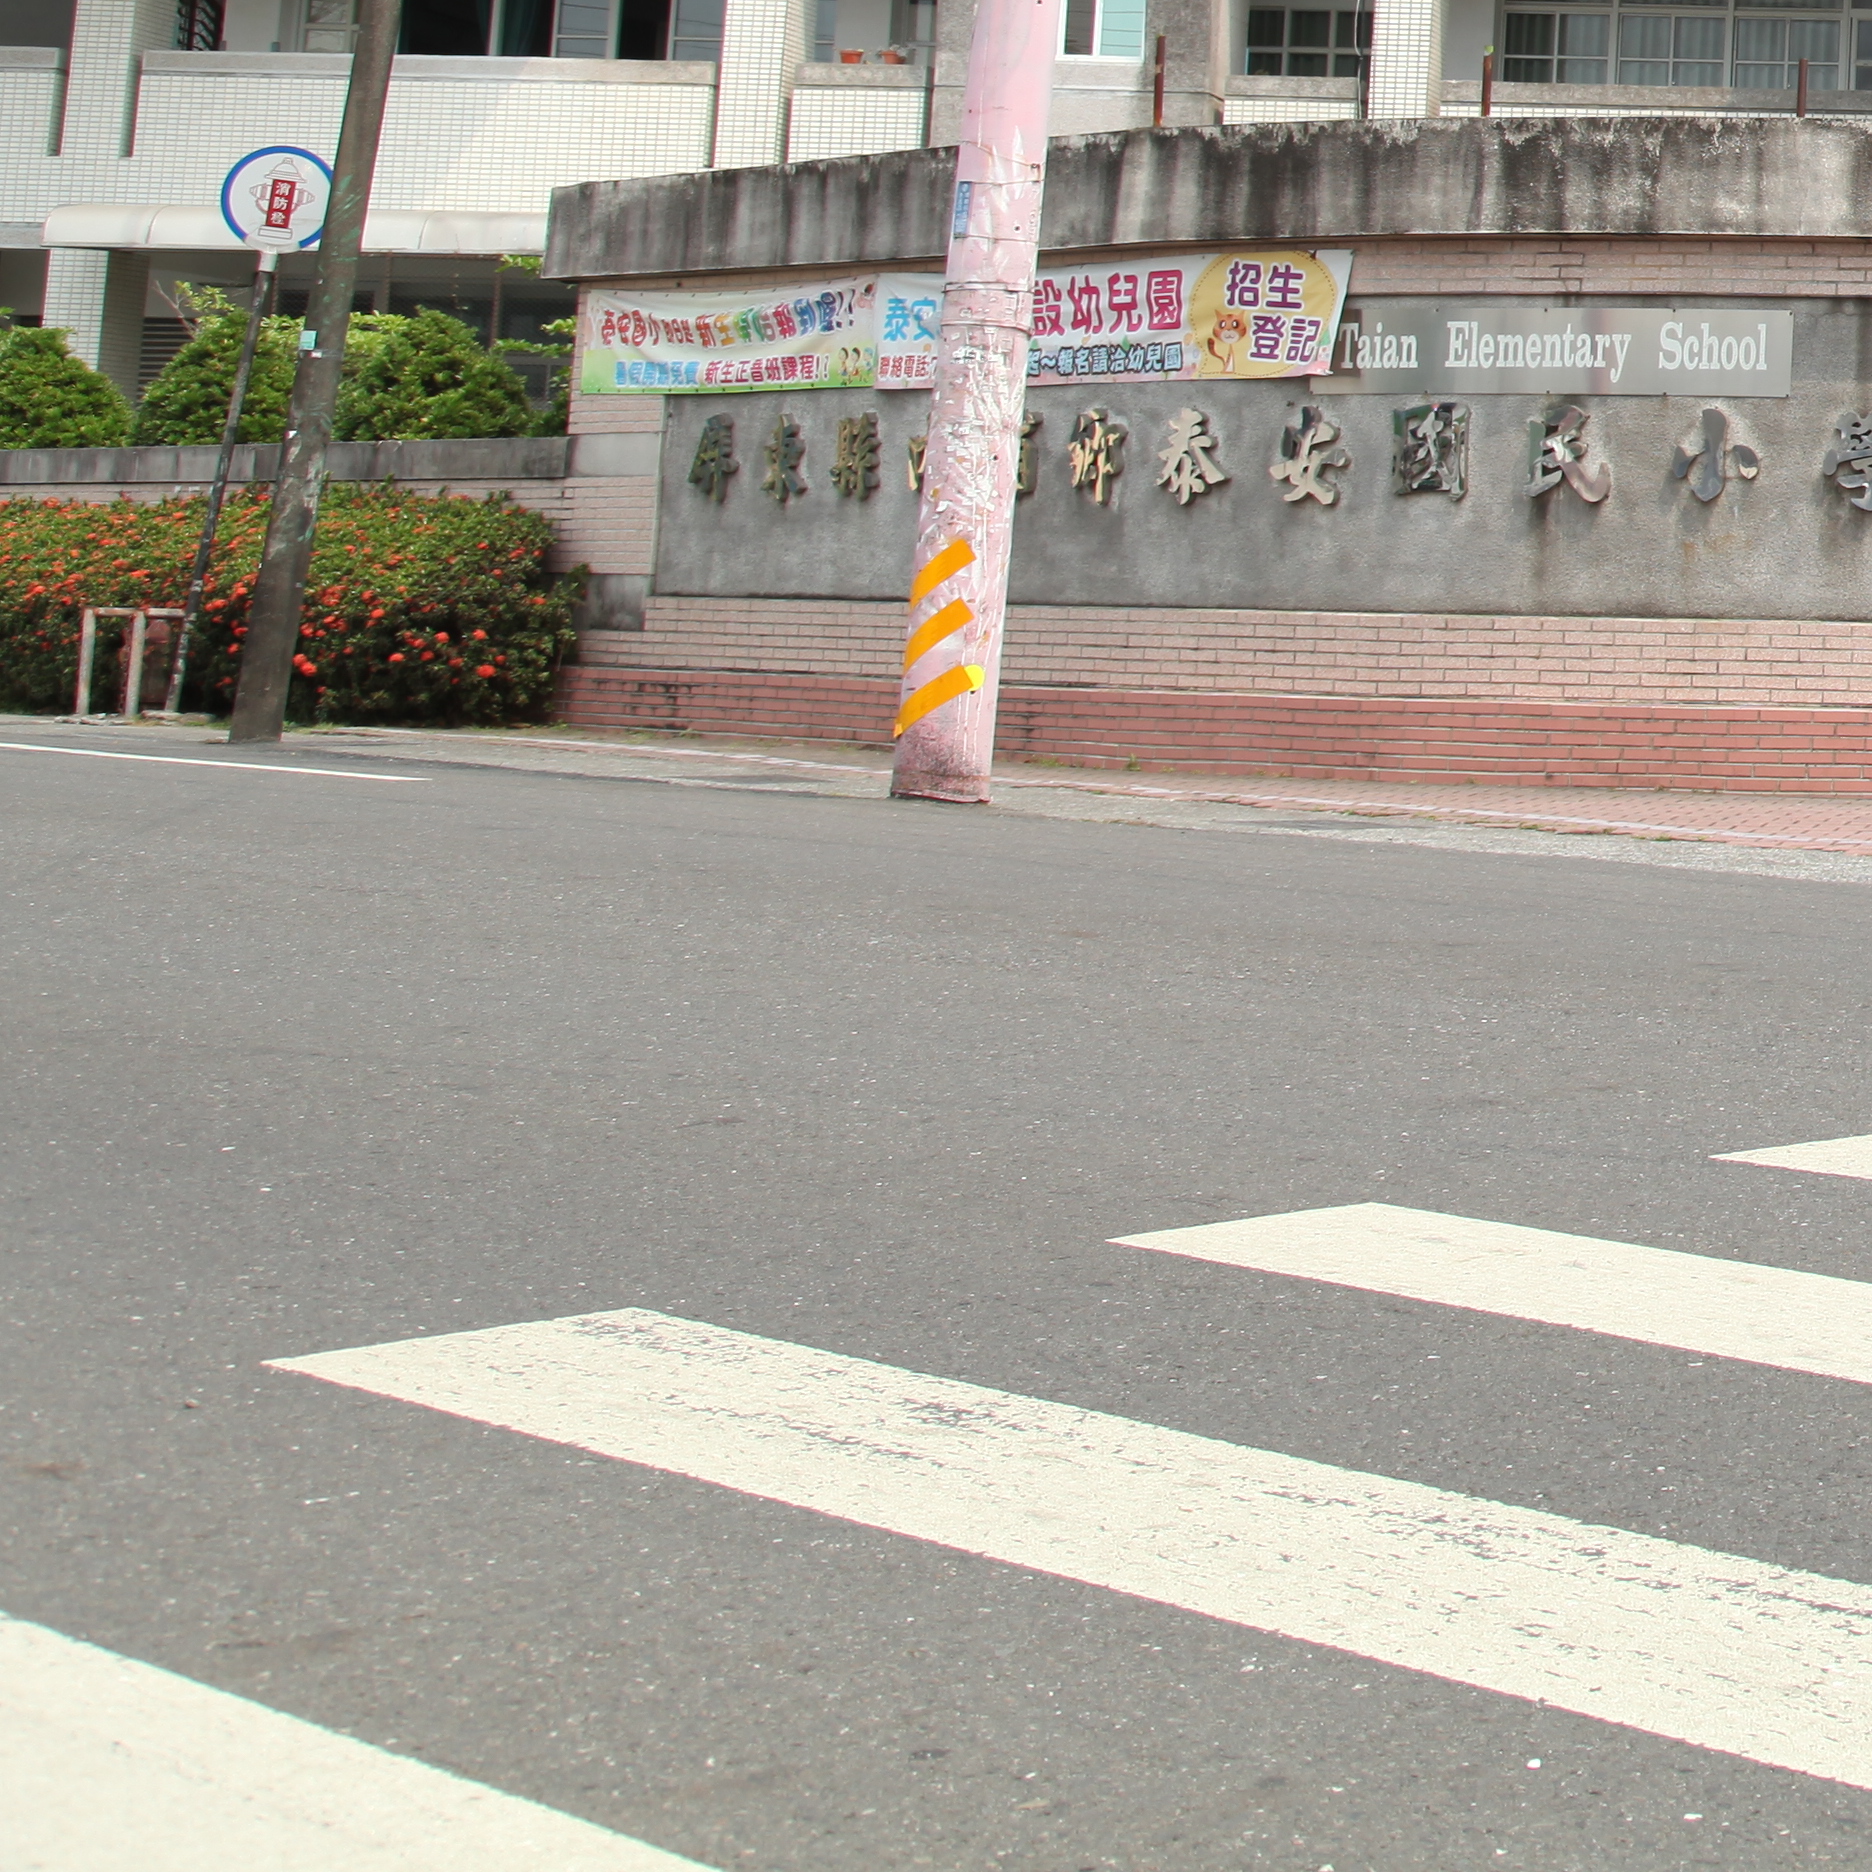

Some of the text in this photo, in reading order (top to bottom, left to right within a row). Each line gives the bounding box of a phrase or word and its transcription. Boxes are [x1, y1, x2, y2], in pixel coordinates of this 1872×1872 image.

[271, 181, 291, 225] 消防栓
[1225, 260, 1304, 310] 招生
[1249, 315, 1323, 362] 登記
[1339, 320, 1768, 383] Taian Elementary School
